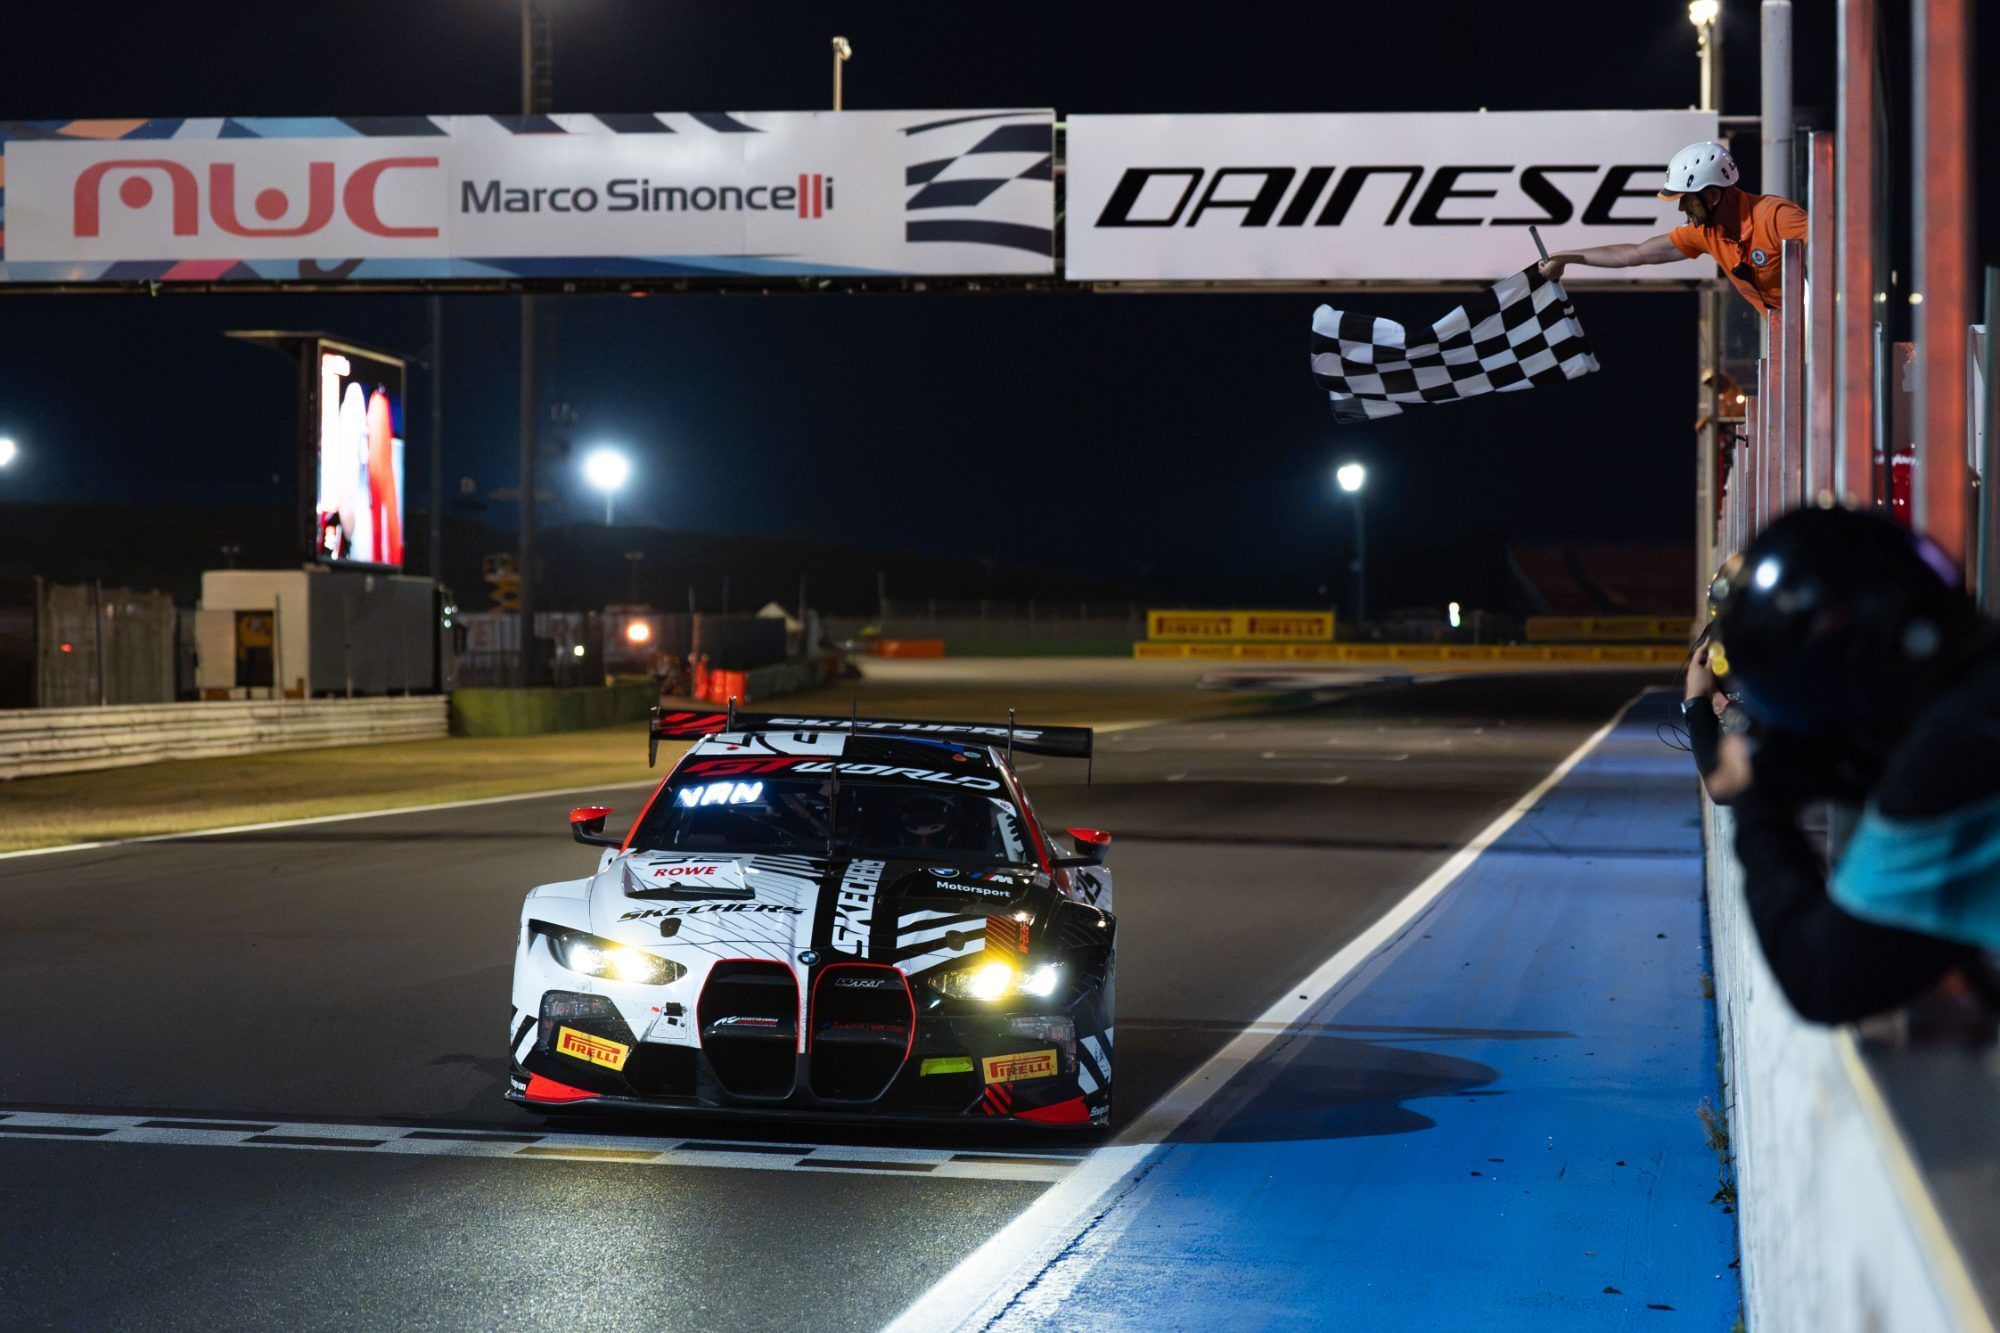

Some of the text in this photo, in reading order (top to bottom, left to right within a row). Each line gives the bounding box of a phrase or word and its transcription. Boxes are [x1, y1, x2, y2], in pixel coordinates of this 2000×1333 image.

[461, 172, 834, 219] Marco Simoncelli
[1095, 165, 1668, 228] DAINESE
[682, 757, 1000, 790] GT WORLD
[677, 781, 764, 808] VAN
[653, 866, 718, 877] ROWE
[936, 880, 1011, 898] Motorsport
[618, 903, 807, 922] SKECHERS
[831, 858, 887, 959] SKECHERS
[562, 1033, 621, 1064] PIRELLI
[989, 1055, 1051, 1079] PIRELLI
